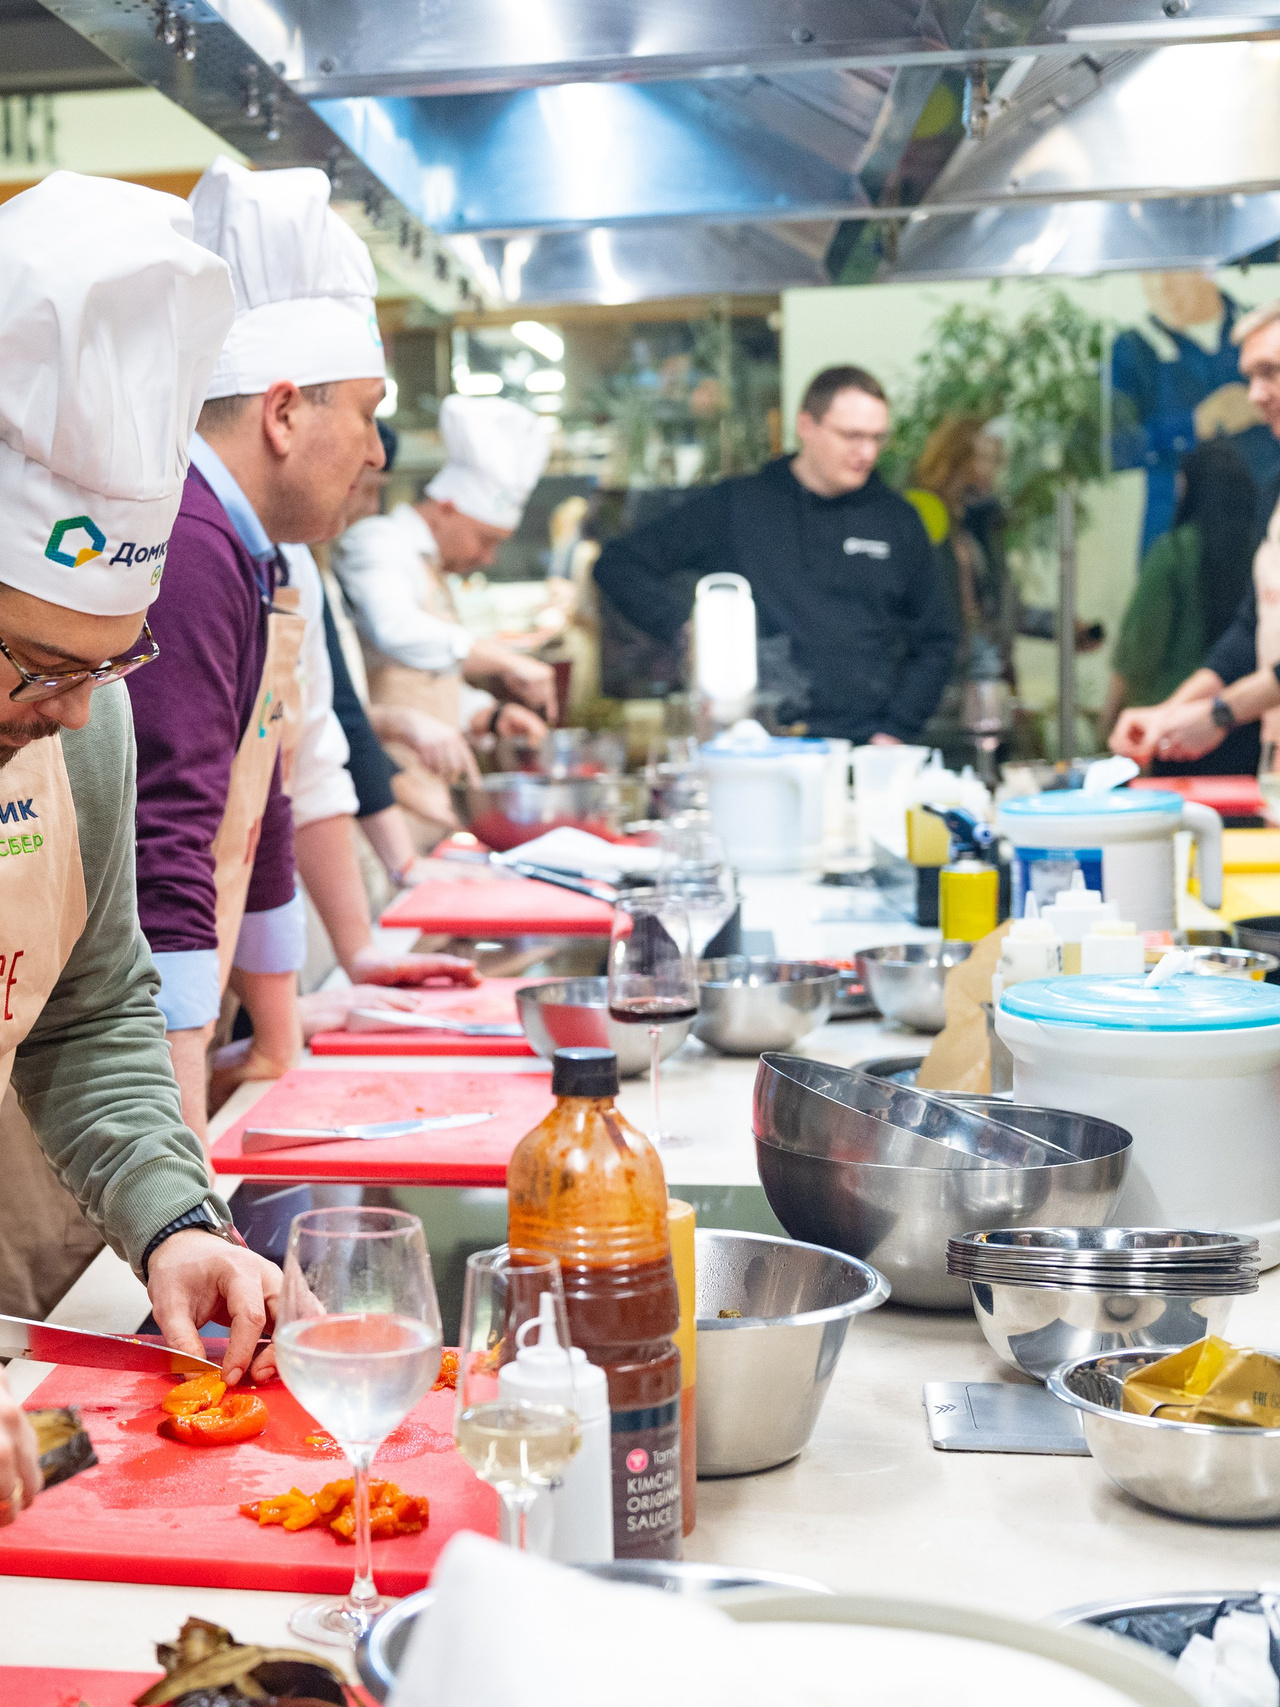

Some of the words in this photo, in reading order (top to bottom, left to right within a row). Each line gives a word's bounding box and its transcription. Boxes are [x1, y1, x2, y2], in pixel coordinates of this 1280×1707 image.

[627, 1470, 673, 1494] KIMCHI
[626, 1484, 681, 1513] ORIGINA
[626, 1506, 672, 1533] SAUCE
